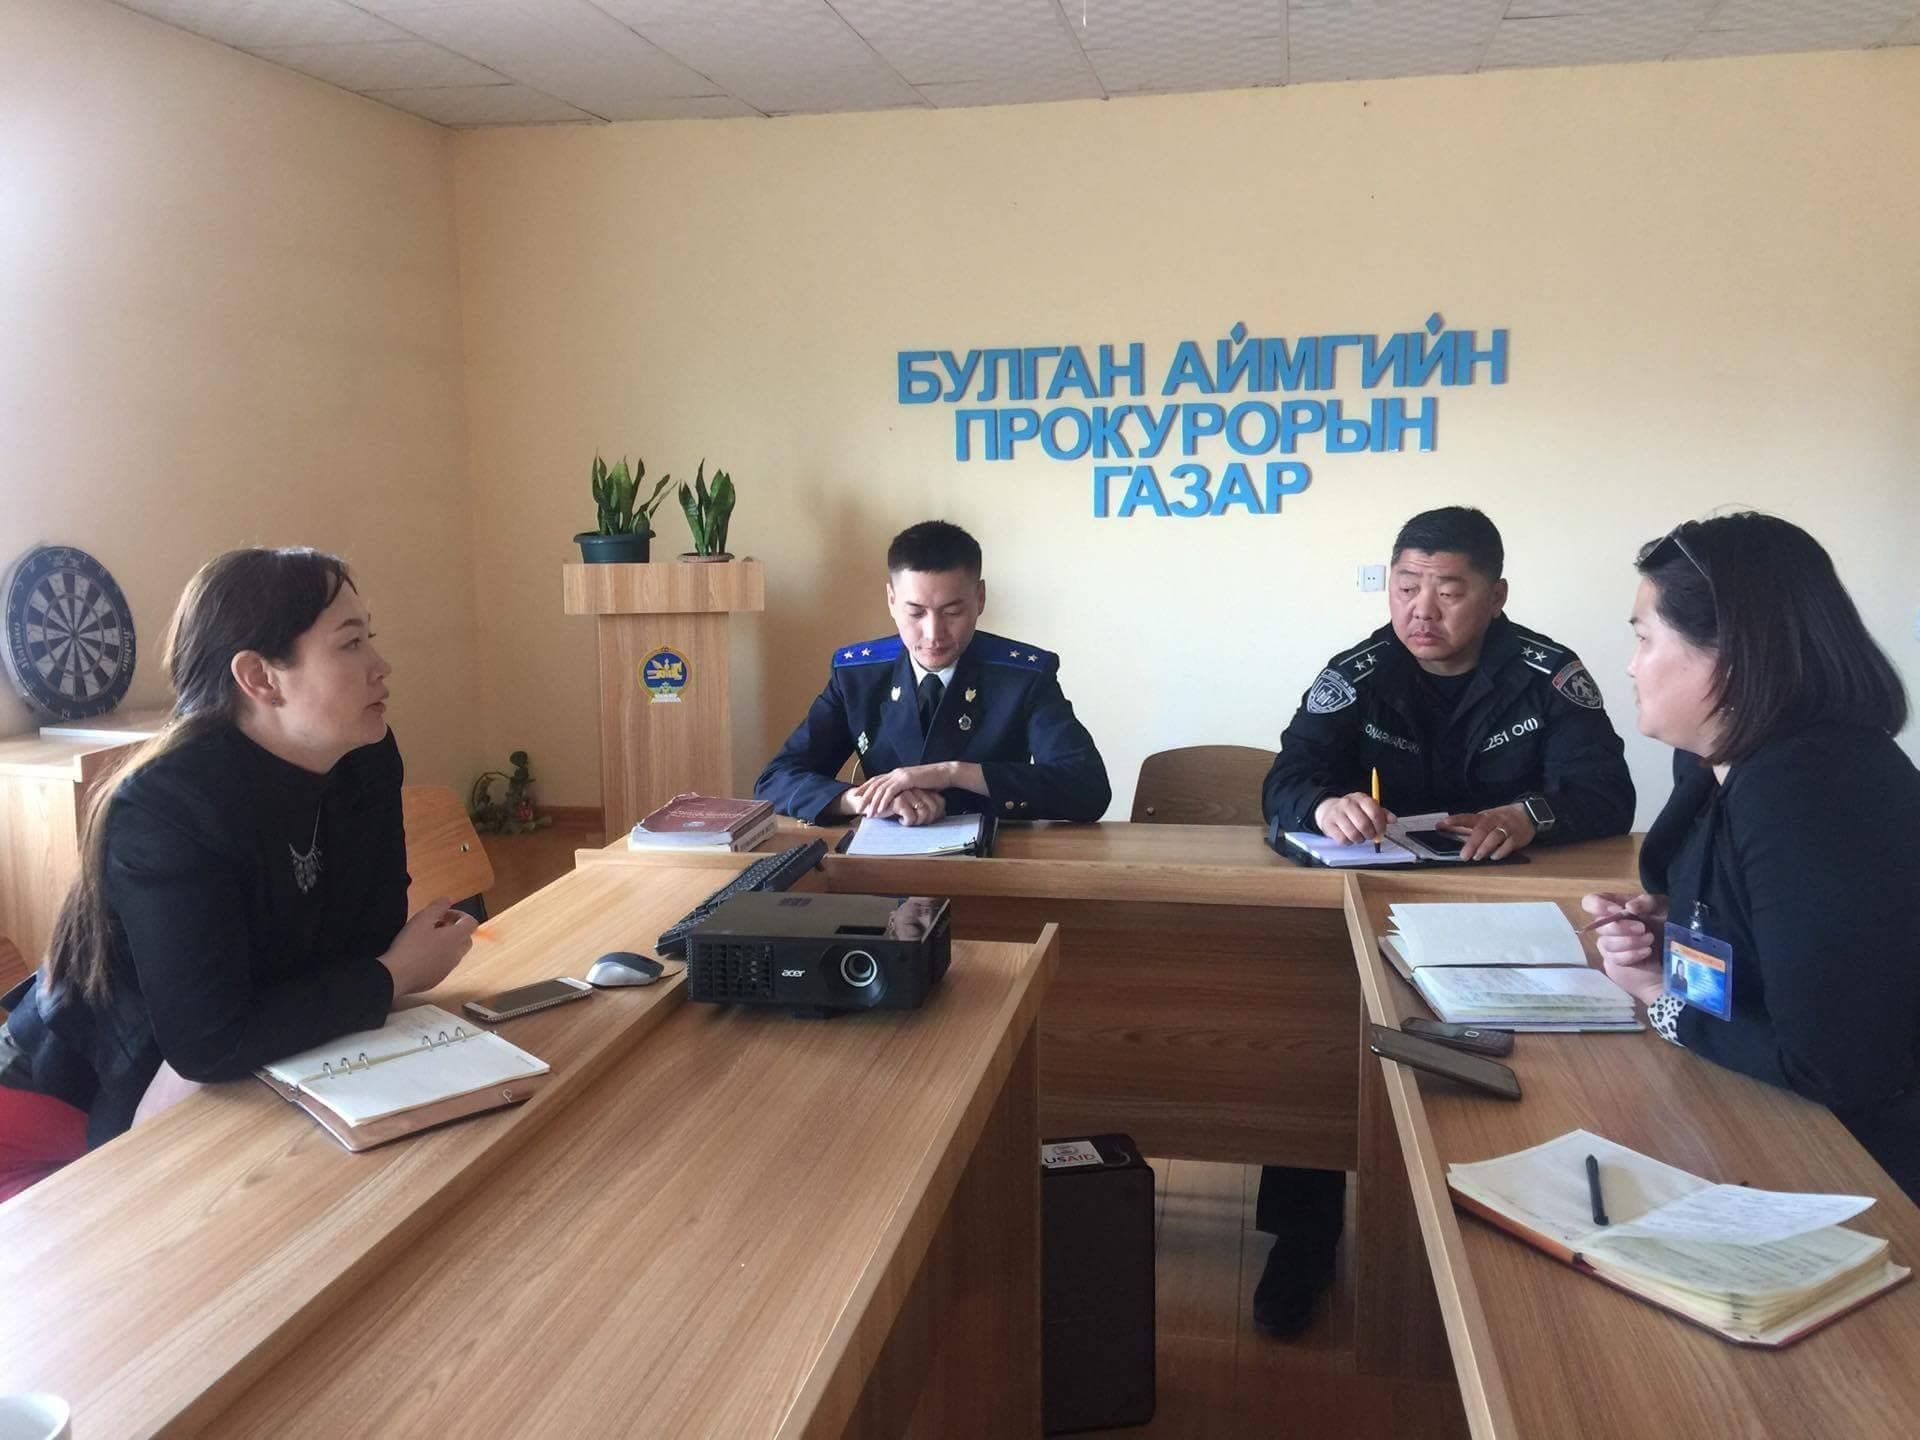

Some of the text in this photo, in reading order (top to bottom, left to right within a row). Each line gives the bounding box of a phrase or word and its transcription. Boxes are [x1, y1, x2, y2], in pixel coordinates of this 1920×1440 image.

[897, 313, 1509, 404] БУЛГАН АЙМГИЙН
[955, 396, 1437, 461] ПРОКУРОРЫН
[1093, 461, 1312, 518] ГАЗАР
[781, 968, 806, 978] acer
[1044, 1152, 1097, 1164] USAID
